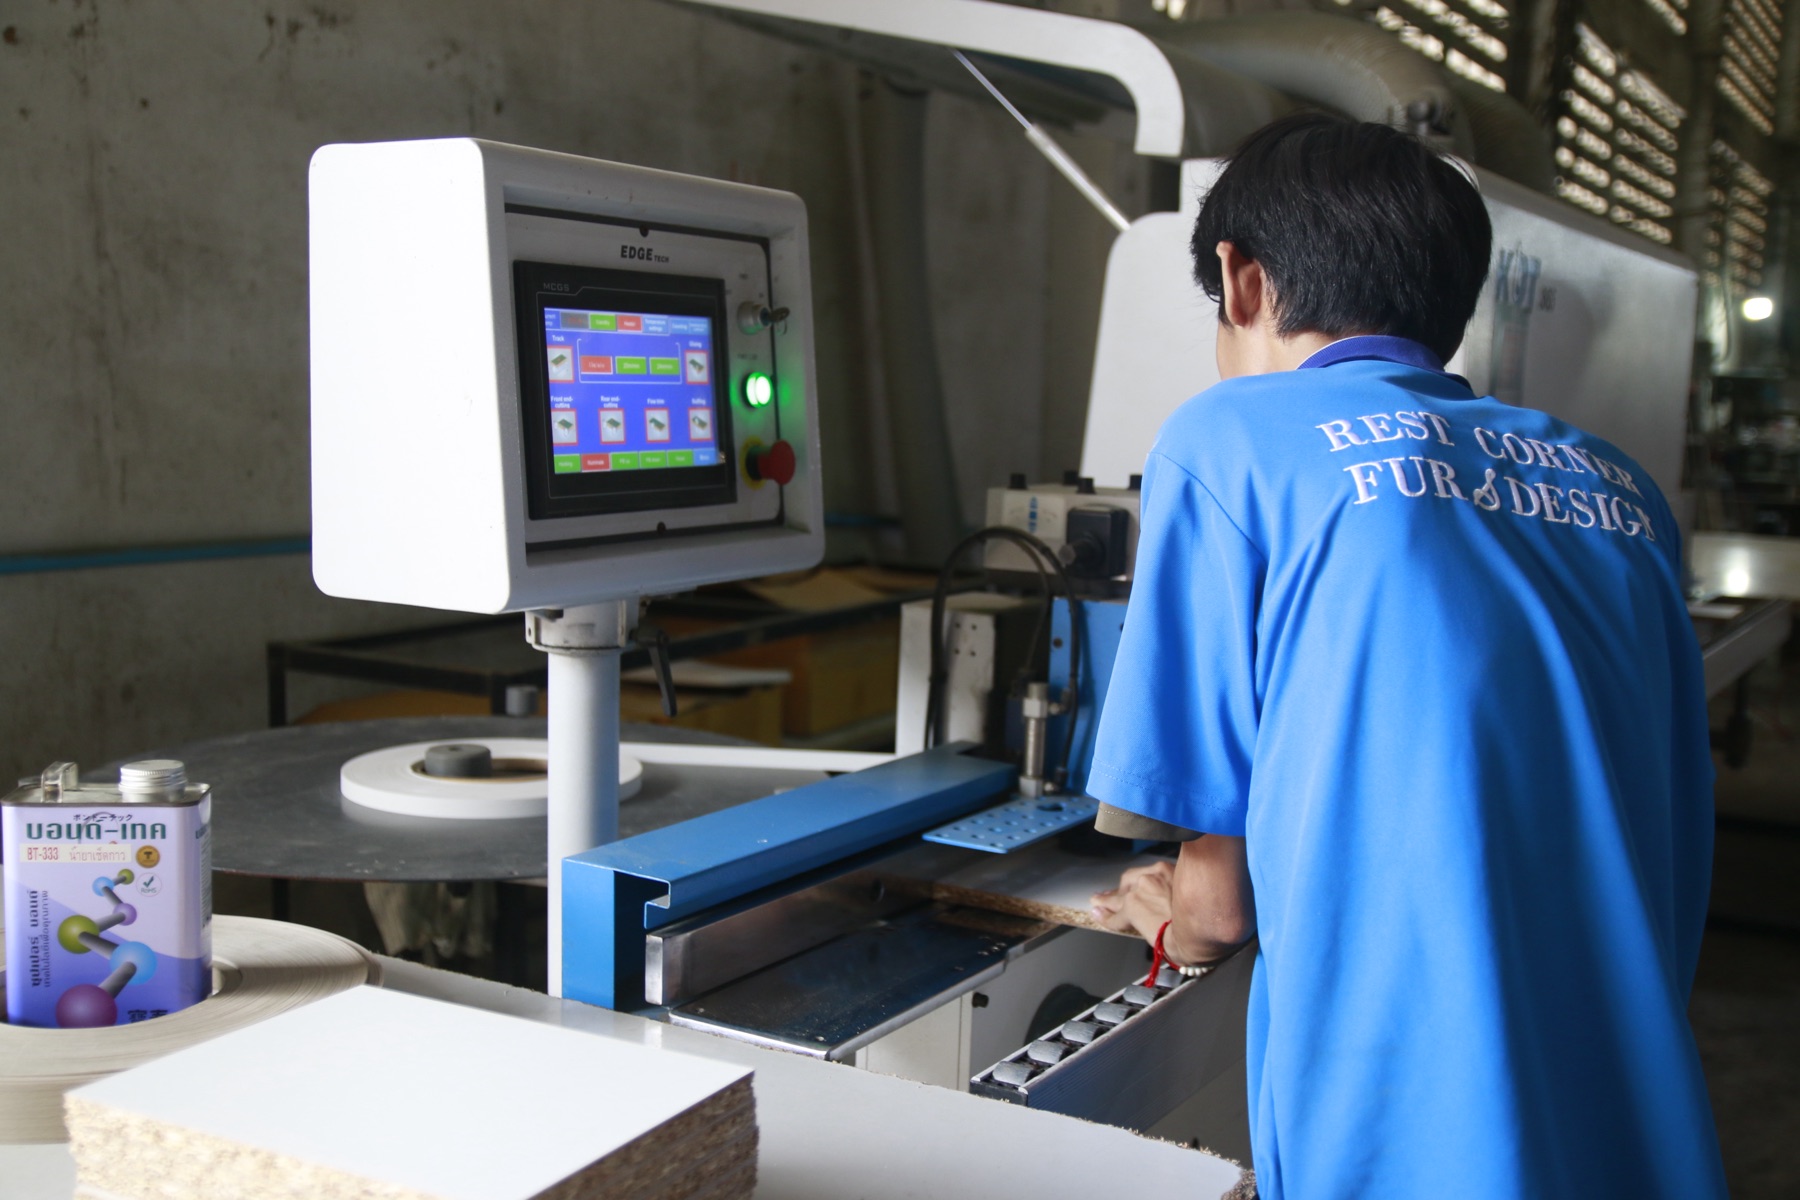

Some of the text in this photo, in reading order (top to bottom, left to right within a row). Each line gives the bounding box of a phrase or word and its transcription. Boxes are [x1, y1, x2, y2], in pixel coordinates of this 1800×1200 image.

[620, 244, 669, 263] EDGE TECH
[543, 282, 570, 292] MCGS
[1315, 411, 1645, 499] REST CORNER
[1343, 456, 1469, 505] FUR
[27, 847, 59, 861] BT-333
